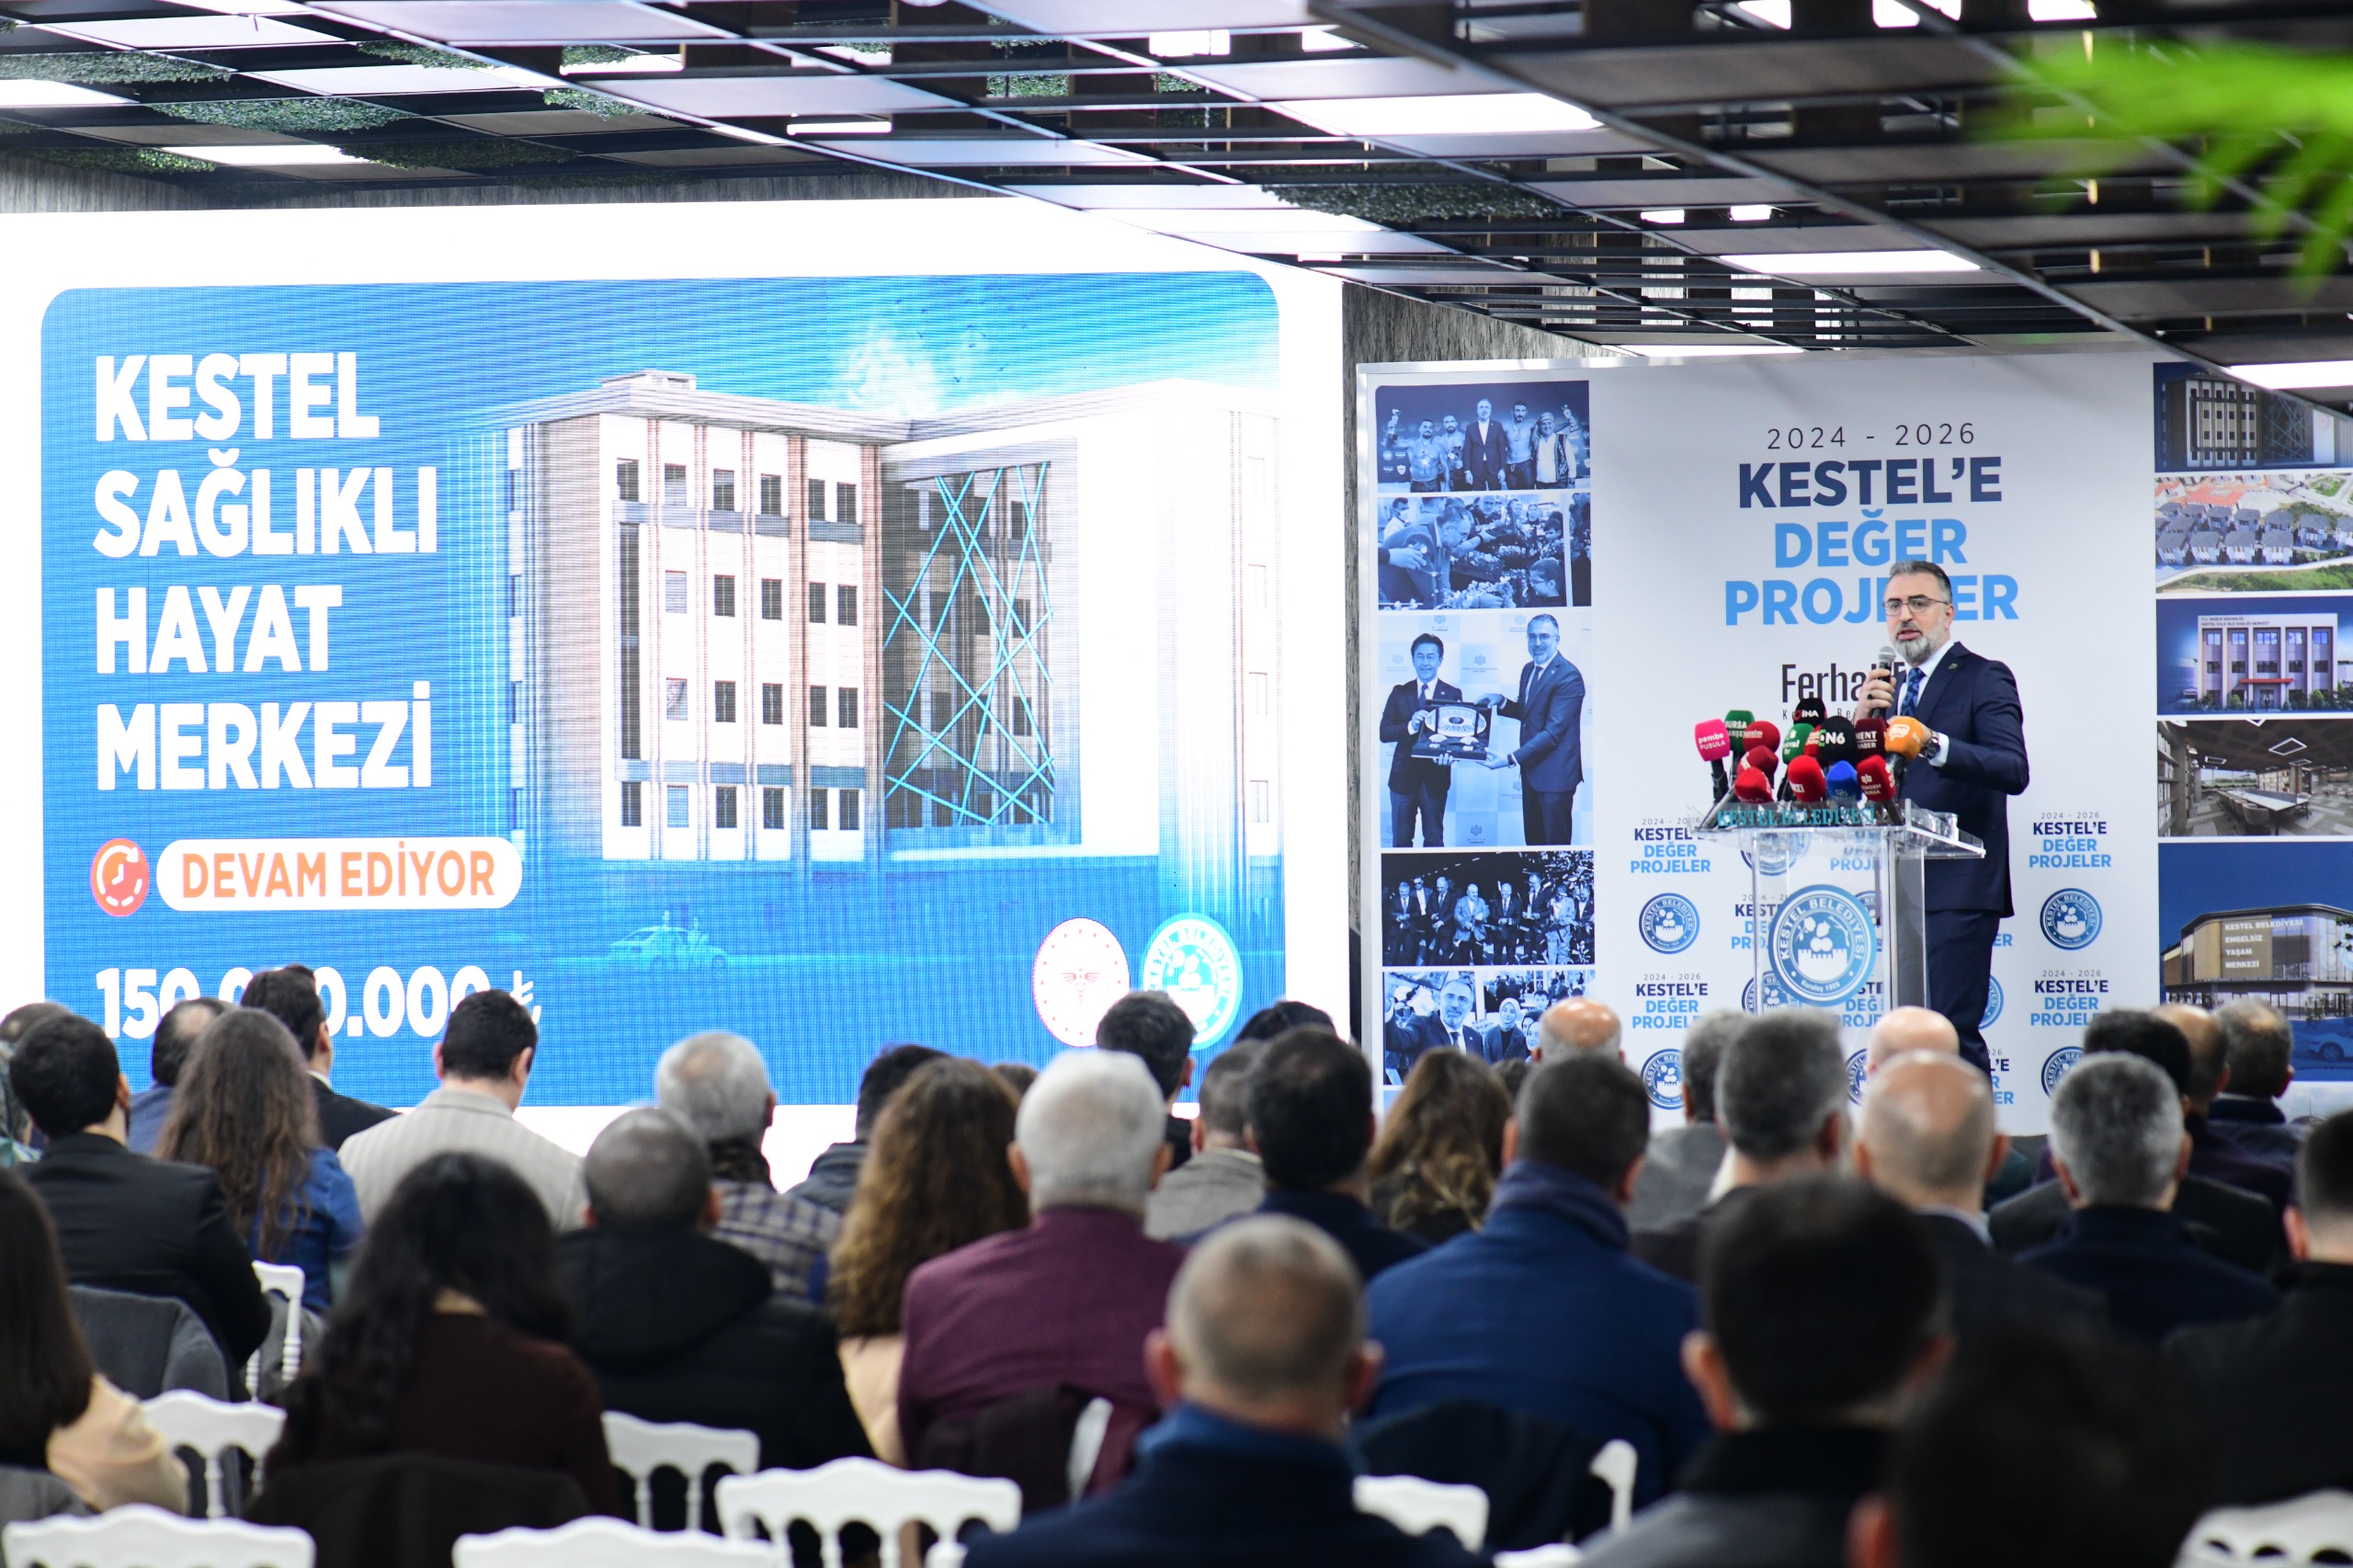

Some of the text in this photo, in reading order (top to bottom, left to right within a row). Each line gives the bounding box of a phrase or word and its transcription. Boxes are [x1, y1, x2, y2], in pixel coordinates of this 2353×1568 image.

[96, 352, 380, 441] KESTEL
[1768, 426, 1846, 449] 2024
[1895, 423, 1974, 446] 2026
[1739, 457, 2002, 508] KESTEL'E
[93, 448, 437, 557] SAĞLIKLI
[1775, 509, 1968, 568] DEĞER
[1725, 574, 2019, 626] PROJER
[97, 585, 343, 673] HAYAT
[1782, 663, 1877, 703] Ferha
[97, 681, 432, 790] MERKEZİ
[1699, 733, 1724, 744] pembe
[1699, 740, 1726, 750] PUSULA
[1717, 808, 1778, 826] KESTEL
[2033, 822, 2107, 835] KESTEL'E
[1644, 842, 1697, 858] DEĞER
[2043, 836, 2097, 852] DEĞER
[182, 840, 494, 898] DEVAM EDİYOR
[1631, 859, 1711, 873] PROJELER
[2029, 855, 2111, 868] PROJELER
[1779, 906, 1806, 960] KESTEL
[2225, 923, 2254, 931] KESTEL
[2226, 948, 2253, 956] YAŞAM
[1636, 983, 1709, 996] KESTEL'E
[2034, 980, 2109, 993] KESTEL'E
[1645, 997, 1699, 1013] DEĞER
[2044, 994, 2098, 1009] DEĞER
